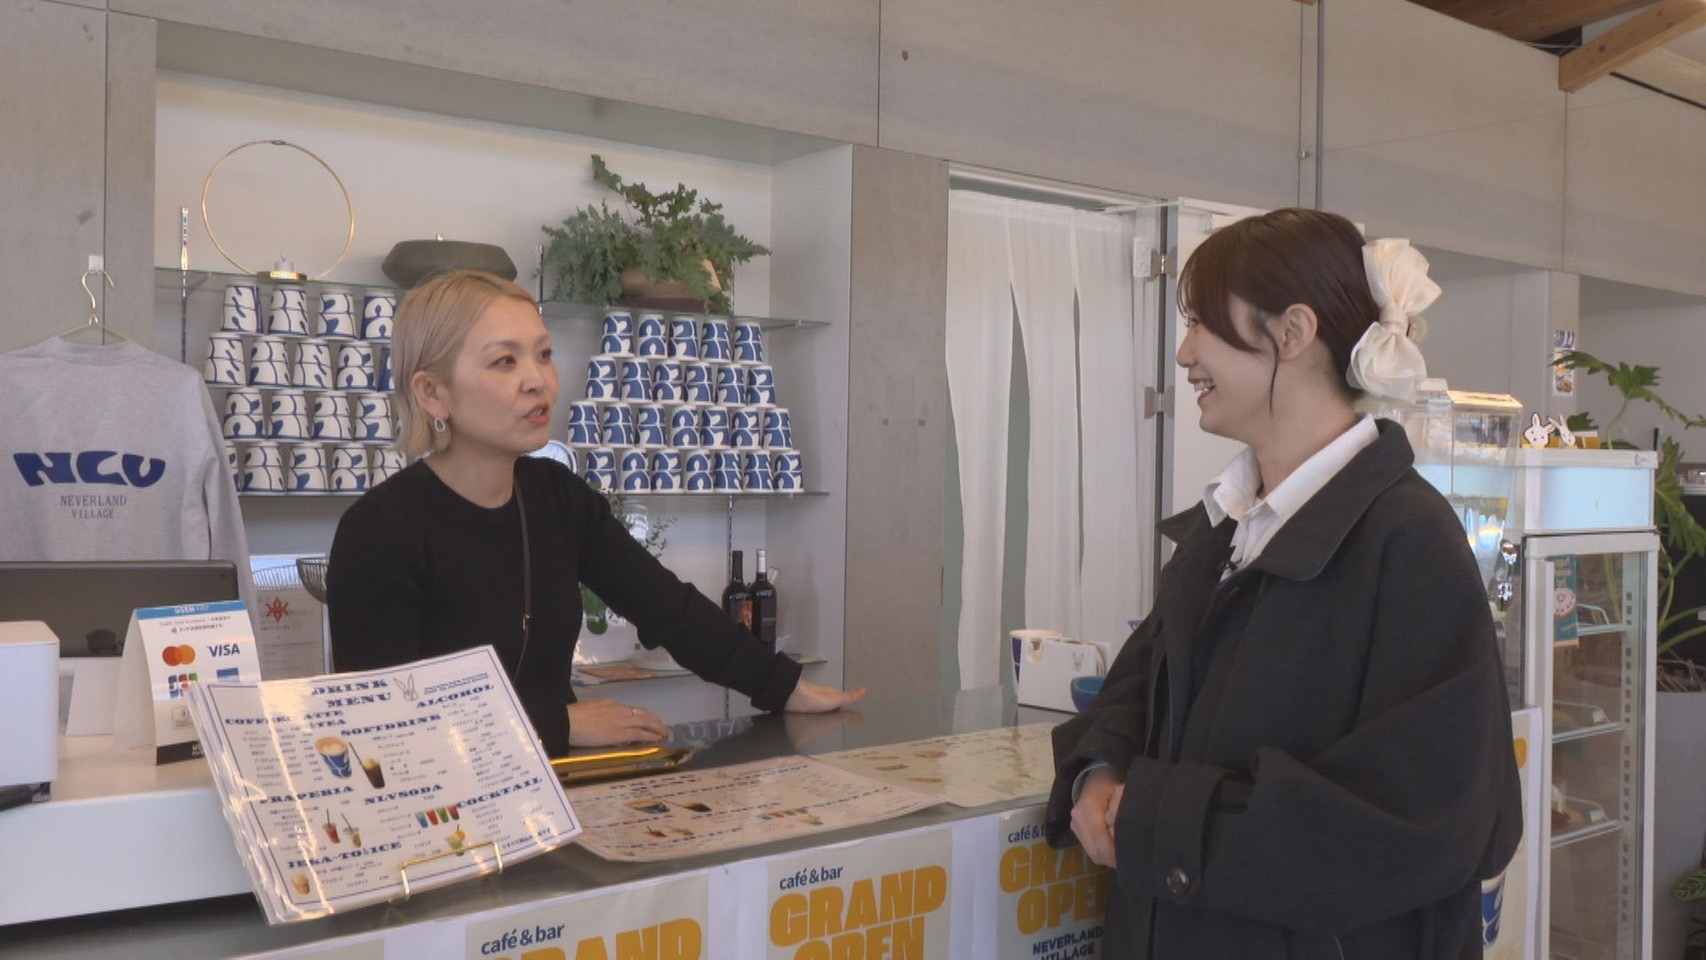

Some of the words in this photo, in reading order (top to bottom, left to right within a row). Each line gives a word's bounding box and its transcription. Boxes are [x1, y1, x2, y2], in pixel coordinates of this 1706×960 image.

[60, 495, 127, 507] NEVERLAND
[72, 509, 114, 520] VILLAGE
[209, 643, 241, 658] VISA
[326, 692, 391, 708] MENU
[416, 683, 495, 708] ALCOHOL
[341, 713, 441, 737] SOFTDRINK
[364, 784, 443, 806] NLVSODA
[456, 777, 543, 808] COCKTAIL
[769, 864, 947, 948] GRAND
[1033, 926, 1104, 955] NEVERLAND
